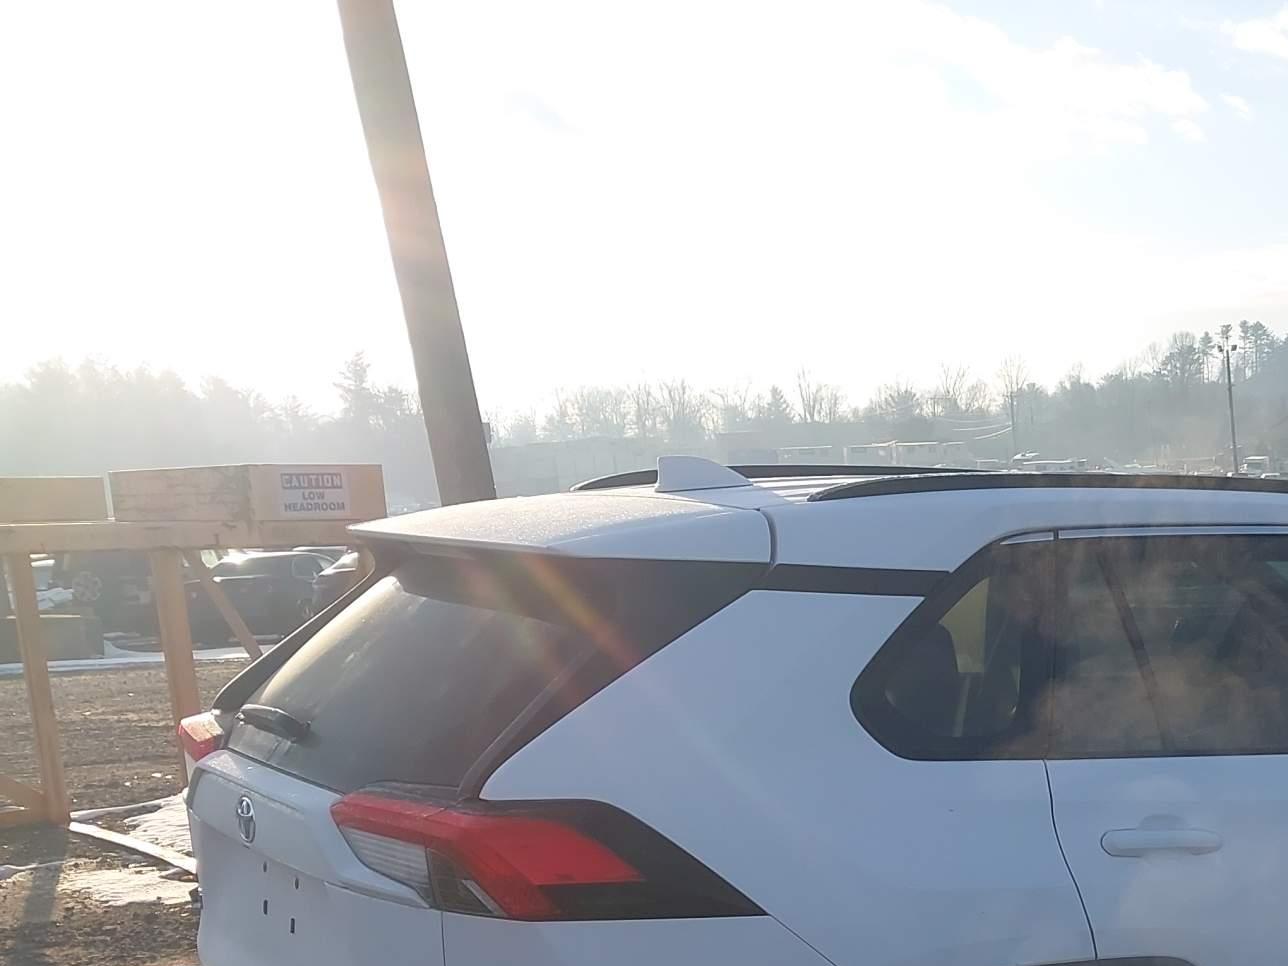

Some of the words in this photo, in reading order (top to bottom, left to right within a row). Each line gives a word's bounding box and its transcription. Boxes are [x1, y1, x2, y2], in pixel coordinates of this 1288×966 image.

[282, 474, 341, 488] CAUTION
[302, 491, 325, 501] LOW
[284, 502, 345, 512] HEADROOM
